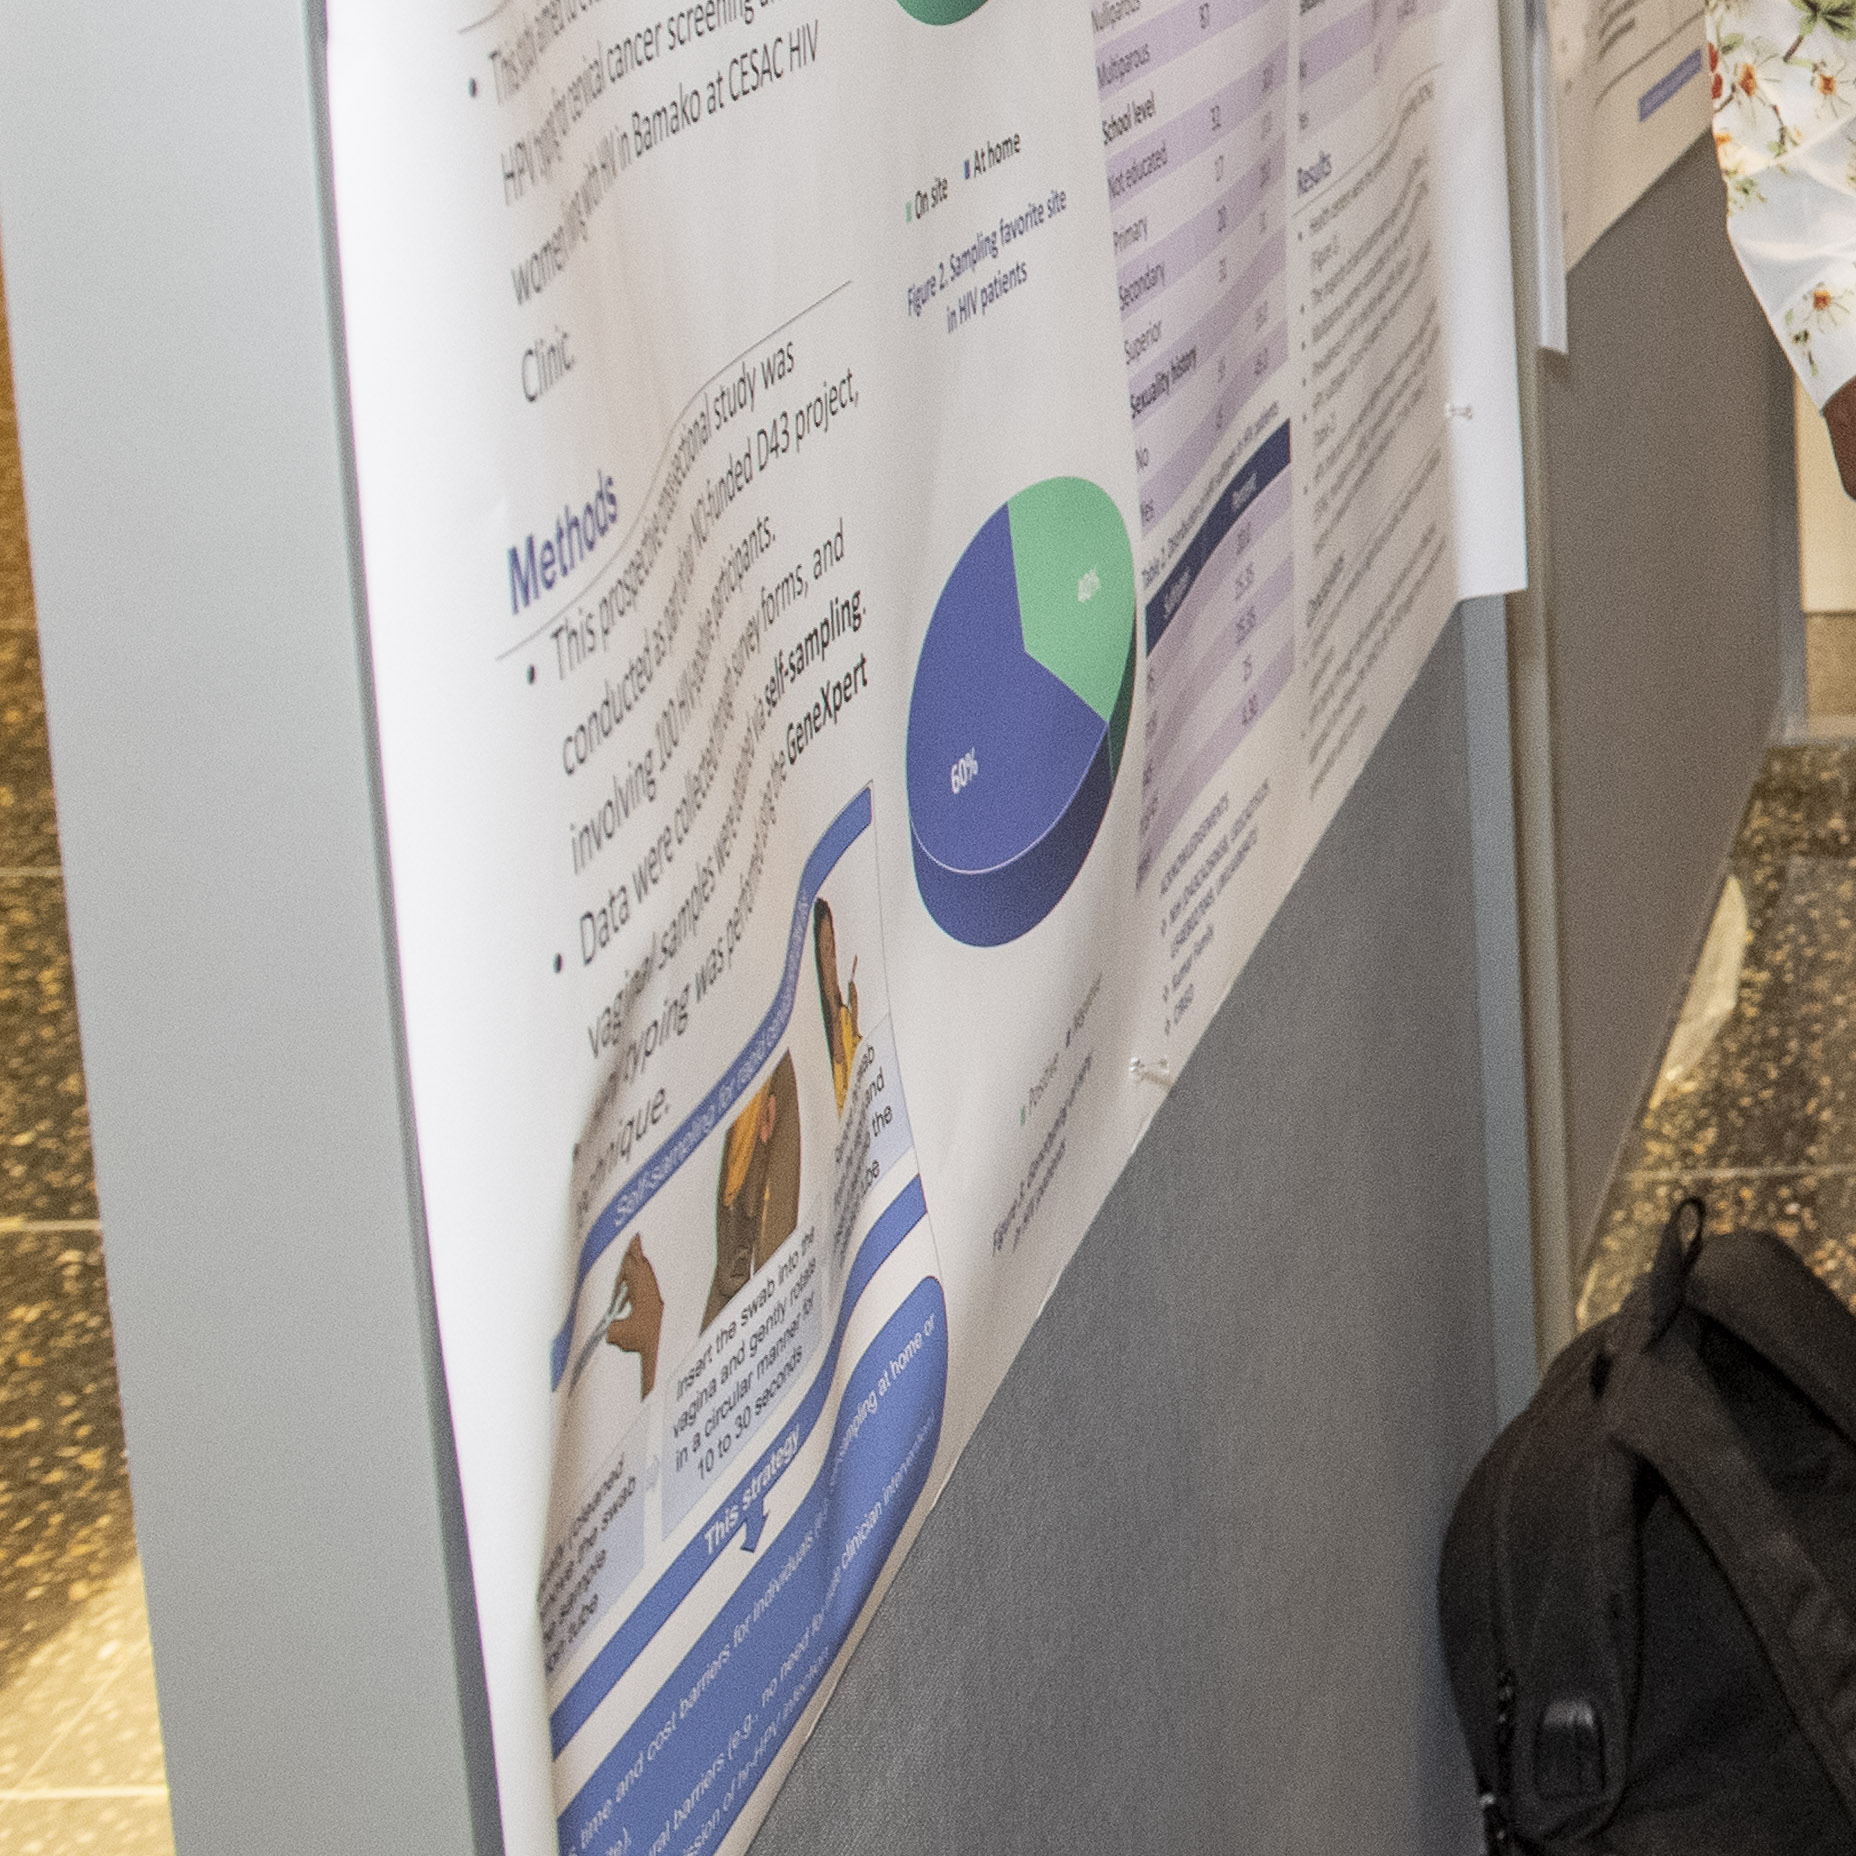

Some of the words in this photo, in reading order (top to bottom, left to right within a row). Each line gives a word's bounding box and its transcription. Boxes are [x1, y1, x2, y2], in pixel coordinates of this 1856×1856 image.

[606, 22, 662, 84] cancer
[615, 123, 632, 172] in
[632, 82, 702, 158] Bamako
[705, 74, 725, 117] at
[727, 49, 785, 104] CESAC
[788, 20, 820, 76] HIV
[1097, 43, 1150, 89] Multiparous
[915, 189, 930, 220] On
[931, 176, 949, 209] site
[973, 149, 987, 178] At
[987, 132, 1021, 169] home
[1102, 105, 1132, 146] School
[1133, 91, 1156, 127] level
[1126, 142, 1168, 184] educated
[907, 274, 937, 317] Figure
[949, 230, 999, 282] Sampling
[999, 202, 1045, 248] favorite
[1046, 188, 1068, 219] site
[946, 304, 958, 334] in
[958, 286, 979, 325] HIV
[980, 260, 1028, 316] patients
[1113, 214, 1148, 255] Primary
[1119, 263, 1165, 311] Secondary
[1124, 319, 1162, 365] Superior
[505, 469, 619, 617] Methods
[550, 605, 597, 682] This
[714, 360, 756, 431] study
[761, 340, 795, 390] was
[563, 626, 654, 777] conducted
[757, 410, 791, 472] D43
[795, 367, 860, 455] project,
[579, 882, 631, 967] Data
[632, 824, 674, 904] were
[761, 562, 809, 632] forms,
[813, 516, 844, 581] and
[658, 854, 716, 971] samples
[765, 589, 867, 718] self-sampling.
[950, 747, 980, 795] 60%
[570, 748, 657, 876] involving
[695, 936, 725, 1005] was
[786, 652, 869, 765] GeneXpert
[871, 1105, 893, 1138] the
[673, 1377, 717, 1439] vagina
[720, 1340, 746, 1387] and
[749, 1297, 788, 1358] gently
[675, 1344, 713, 1401] Insert
[716, 1320, 737, 1355] the
[741, 1277, 775, 1328] swab
[777, 1249, 800, 1284] into
[878, 1369, 892, 1397] at
[889, 1332, 923, 1381] home
[924, 1313, 935, 1337] or
[675, 1447, 689, 1473] in
[692, 1430, 702, 1454] a
[704, 1369, 754, 1438] circular
[756, 1311, 802, 1381] manner
[697, 1448, 715, 1480] 10
[718, 1432, 733, 1459] to
[735, 1405, 752, 1440] 30
[754, 1344, 803, 1416] seconds
[704, 1504, 740, 1555] This
[742, 1424, 801, 1512] strategy
[761, 1677, 778, 1708] no
[779, 1626, 812, 1681] need
[841, 1501, 884, 1569] clinician
[615, 1751, 644, 1802] and
[647, 1711, 677, 1761] cost
[678, 1643, 732, 1720] barriers
[733, 1615, 750, 1648] for
